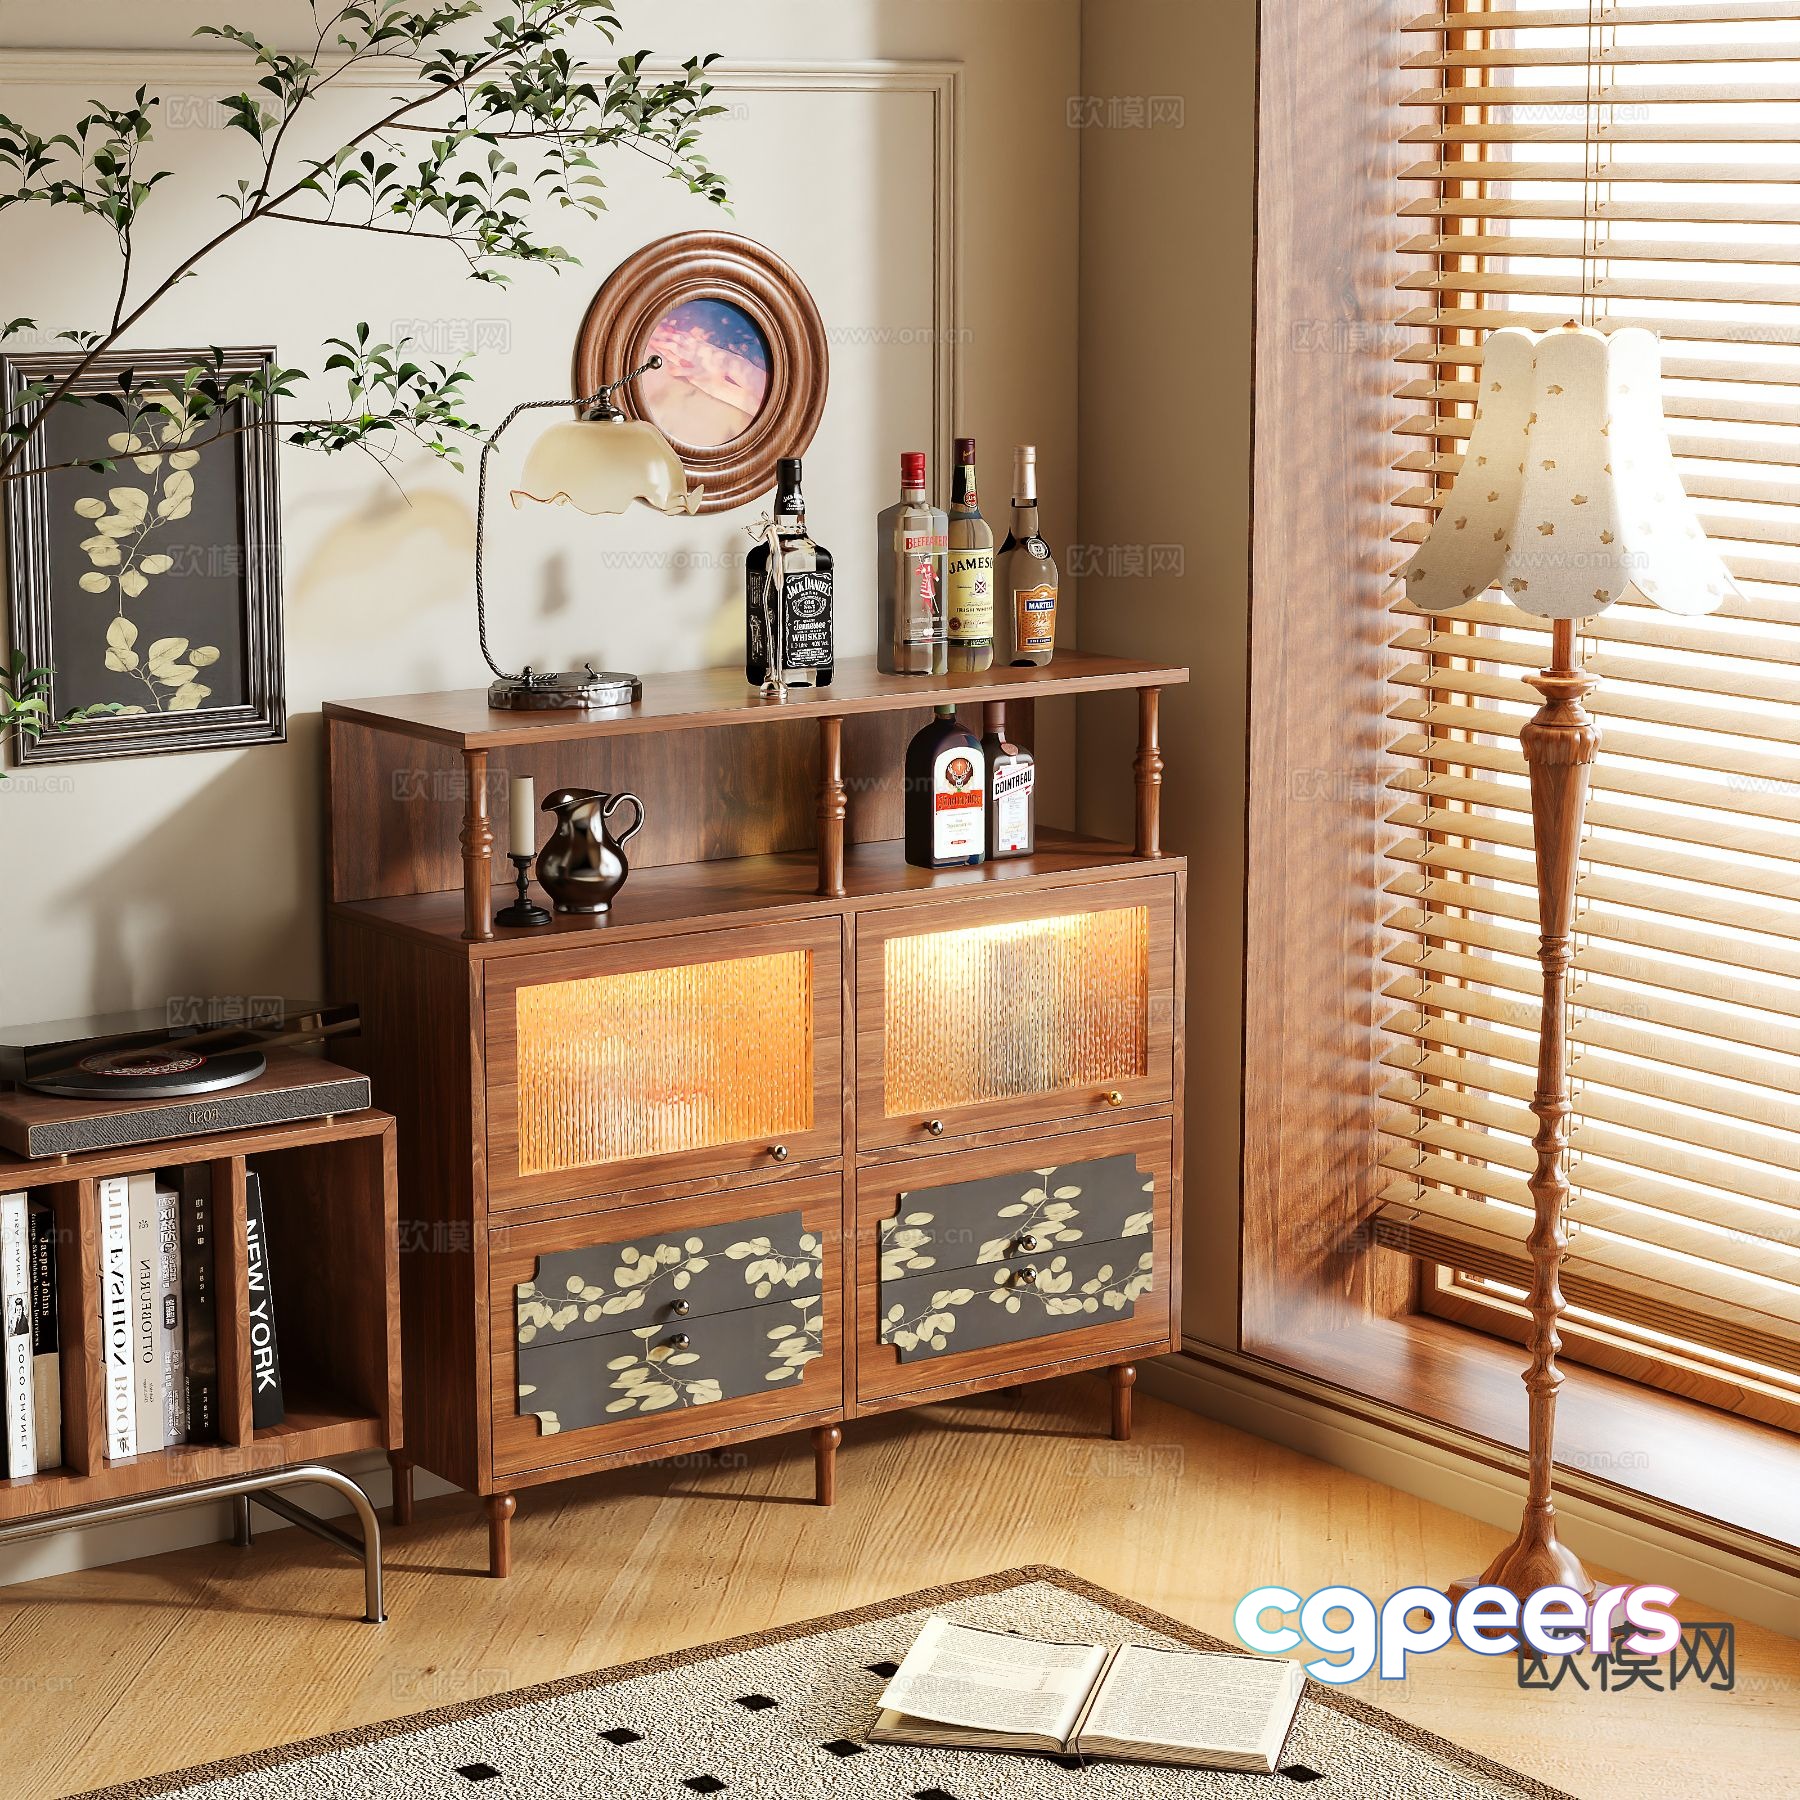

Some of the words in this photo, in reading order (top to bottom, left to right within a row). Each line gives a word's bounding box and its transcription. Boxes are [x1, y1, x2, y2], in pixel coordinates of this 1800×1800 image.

[786, 580, 804, 600] JACK
[1028, 600, 1054, 610] MARTELL
[792, 632, 828, 642] WHISKEY
[995, 770, 1033, 795] COINTREAU
[39, 1237, 49, 1277] Jasper
[246, 1218, 265, 1291] NEW
[41, 1281, 51, 1317] Johns
[249, 1299, 277, 1394] YORK
